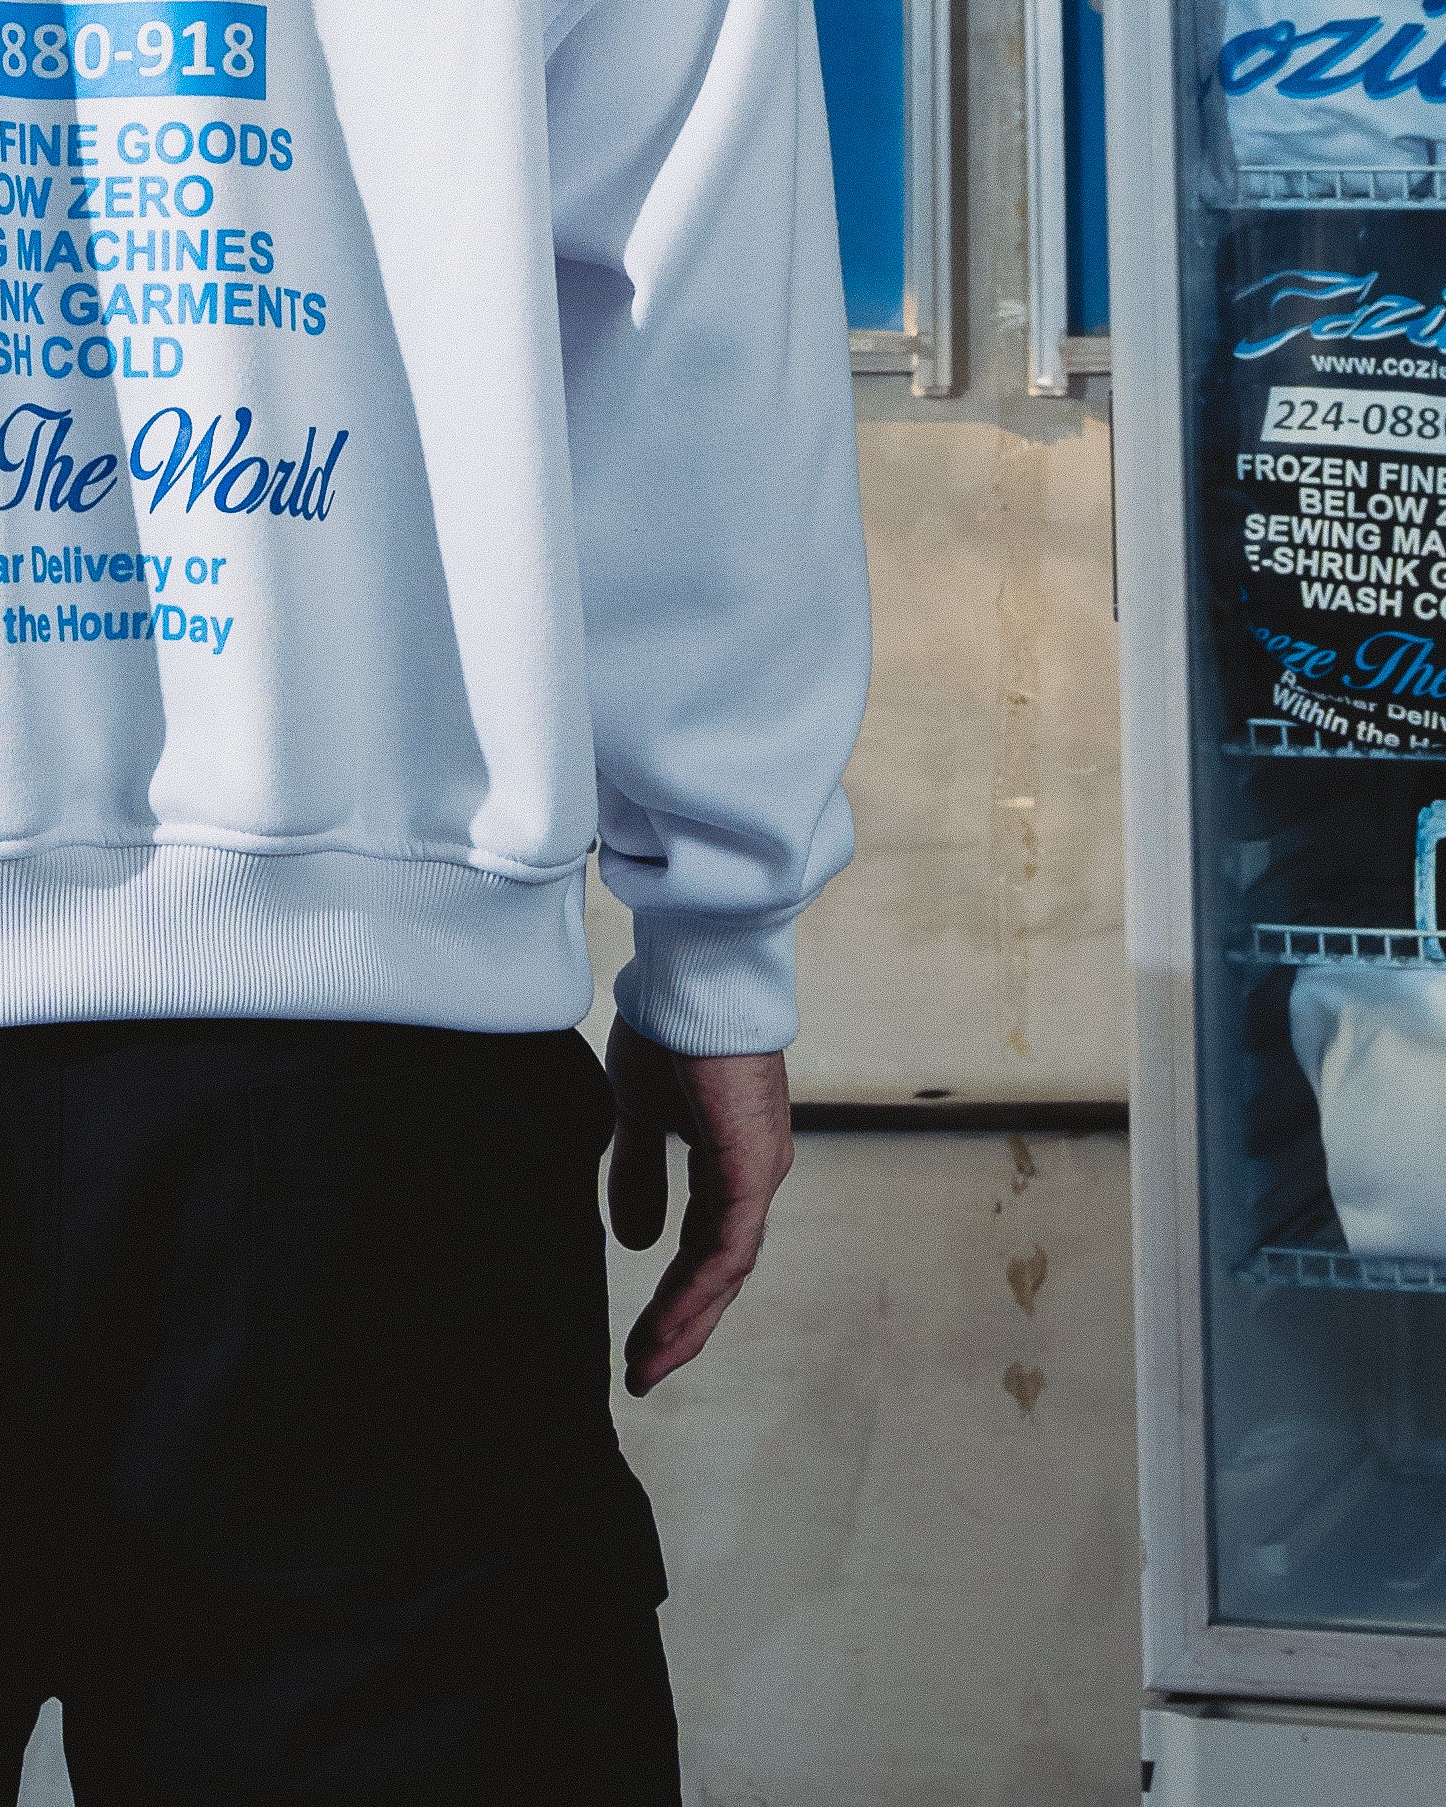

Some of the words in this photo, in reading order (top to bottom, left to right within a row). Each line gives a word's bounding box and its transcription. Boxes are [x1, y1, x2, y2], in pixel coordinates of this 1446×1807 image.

[117, 120, 294, 173] GOODS
[66, 174, 215, 220] ZERO
[16, 227, 275, 275] MACHINES
[59, 280, 328, 337] GARMENTS
[40, 333, 184, 380] COLD
[1272, 399, 1446, 441] 224-088
[128, 406, 350, 522] World
[1236, 453, 1369, 489] FROZEN
[1299, 487, 1429, 525] BELOW
[1243, 513, 1383, 552] SEWING
[32, 544, 173, 594] Delivery
[184, 554, 227, 586] or
[1300, 580, 1404, 619] WASH
[3, 604, 52, 645] the
[57, 602, 234, 655] Hour/Day
